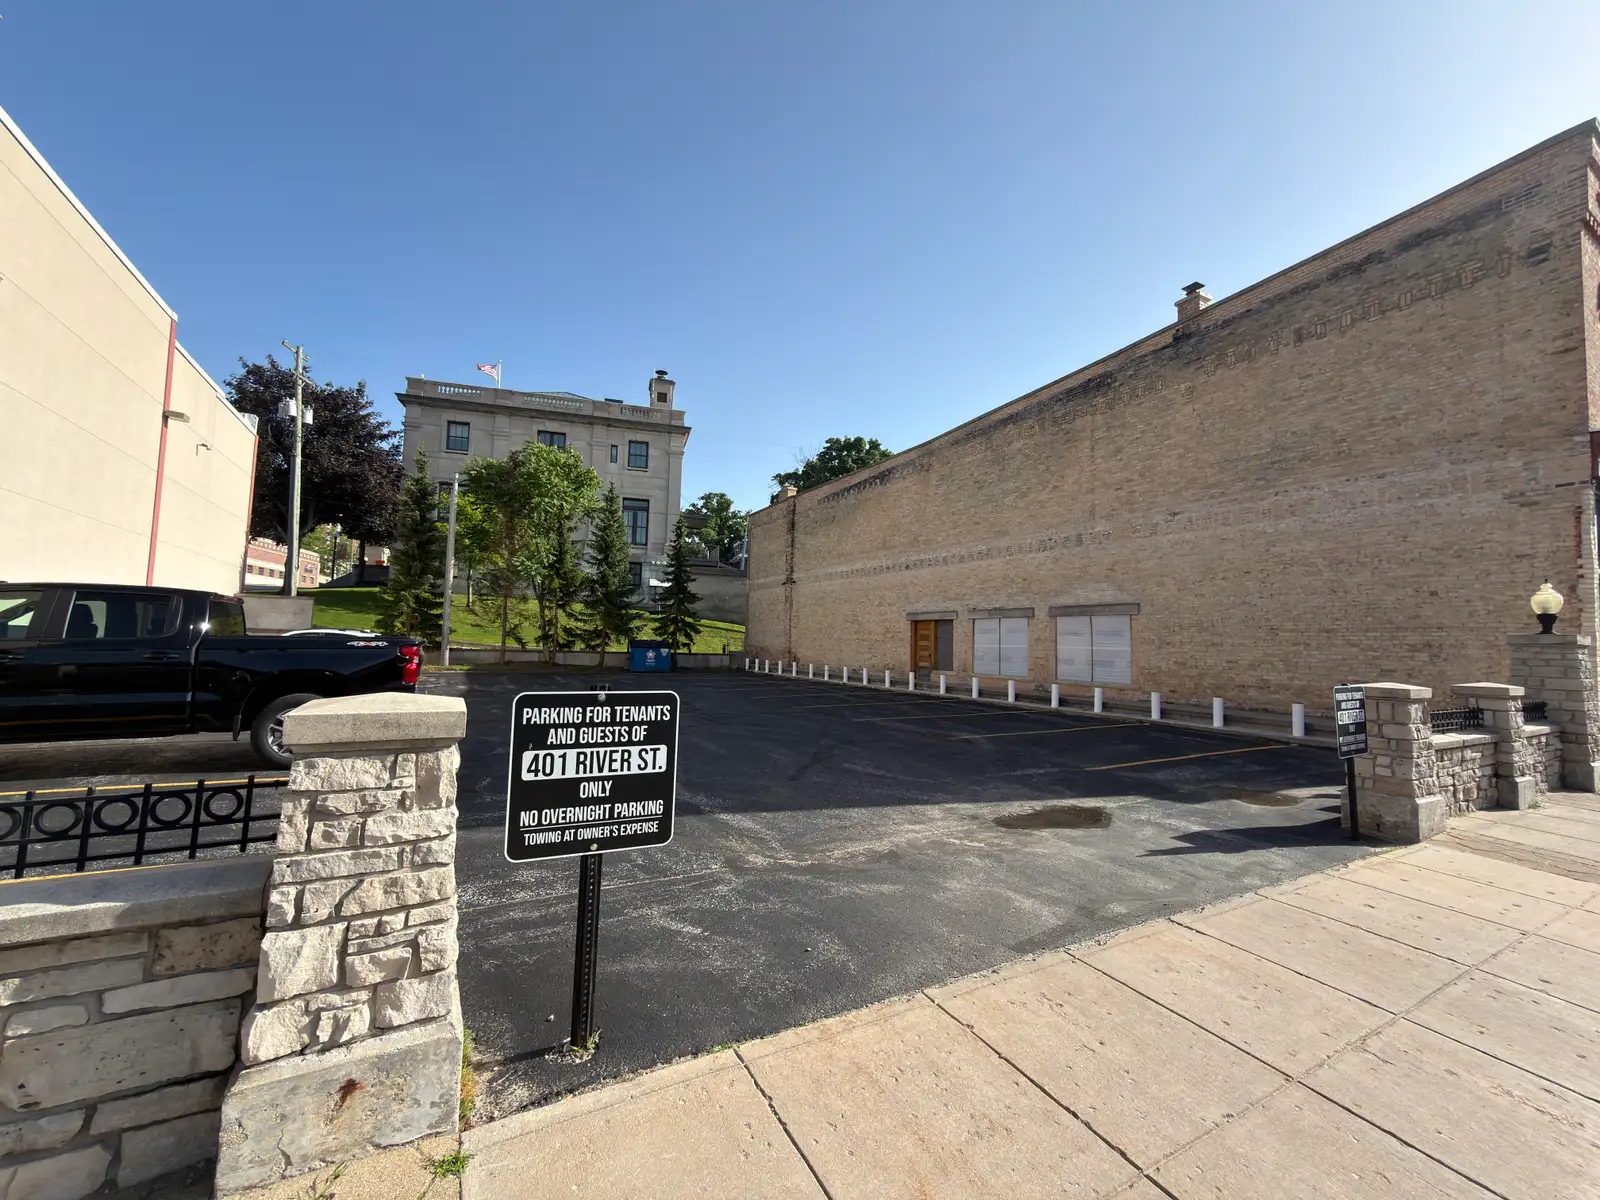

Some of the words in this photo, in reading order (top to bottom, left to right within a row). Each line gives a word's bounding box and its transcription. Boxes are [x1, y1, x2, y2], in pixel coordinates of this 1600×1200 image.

[522, 707, 582, 725] PARKING
[585, 706, 611, 723] FOR
[614, 705, 671, 722] TENANTS
[547, 729, 576, 745] AND
[579, 726, 629, 744] GUESTS
[631, 725, 648, 741] OF
[526, 752, 567, 778] 401
[575, 748, 632, 775] RIVER
[637, 747, 663, 771] ST.
[579, 780, 613, 799] ONLY
[520, 810, 538, 827] NO
[541, 803, 612, 825] OVERNIGHT
[614, 799, 664, 818] PARKING
[524, 831, 562, 846] TOWING
[563, 829, 576, 841] AT
[577, 825, 619, 841] OWNER'S
[620, 820, 660, 836] EXPENSE
